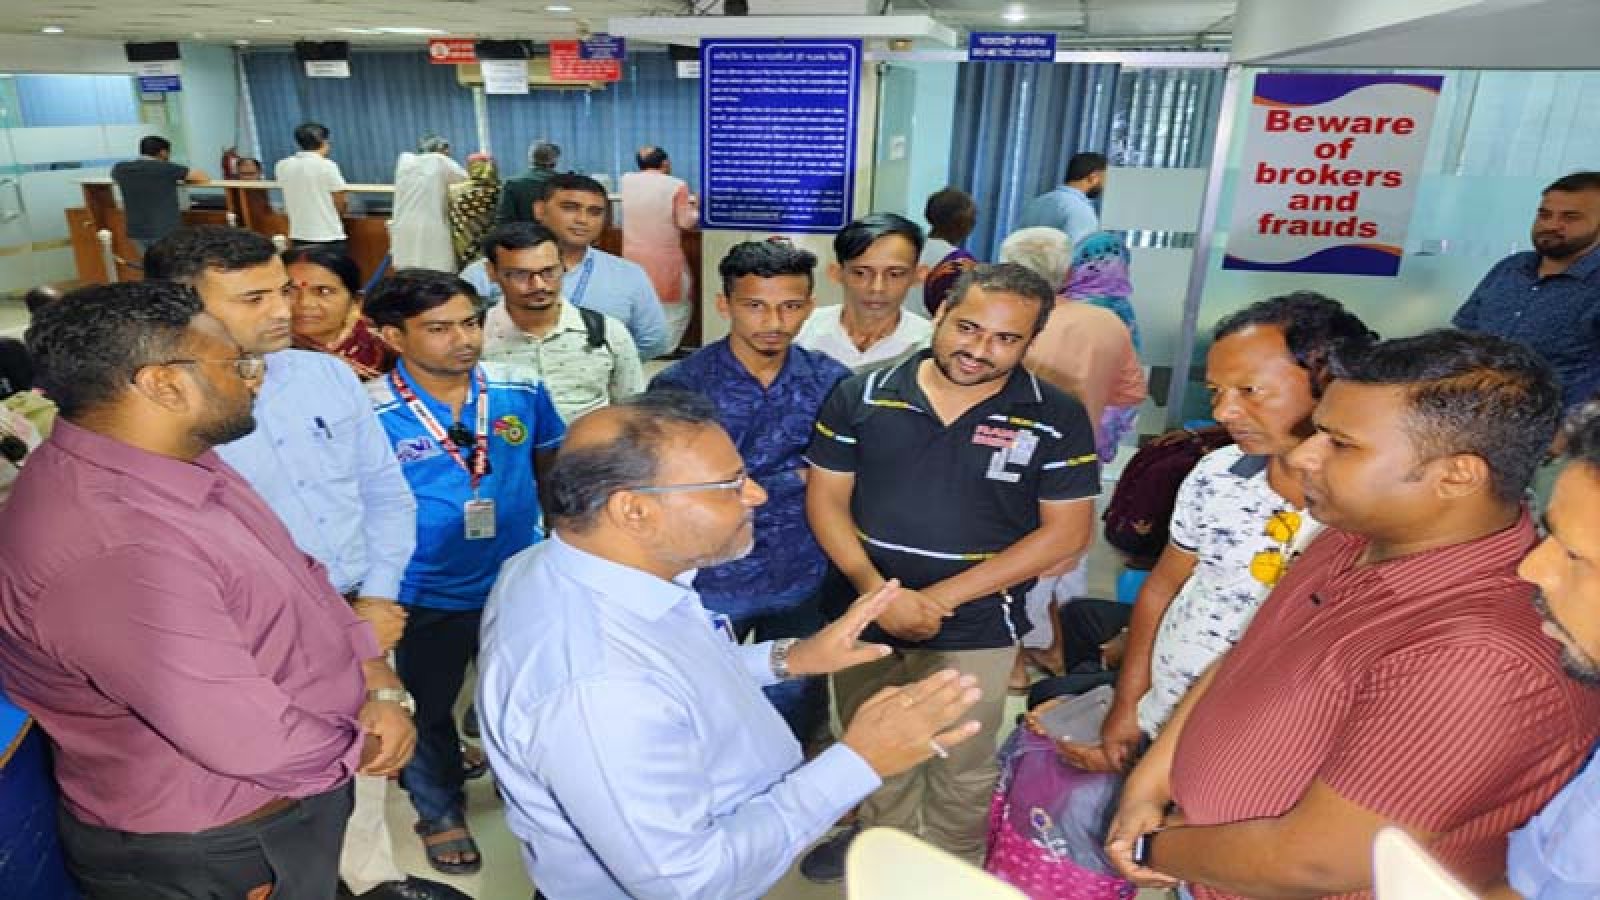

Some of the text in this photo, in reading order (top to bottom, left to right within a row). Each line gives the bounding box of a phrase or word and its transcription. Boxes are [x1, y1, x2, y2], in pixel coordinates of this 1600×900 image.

[1264, 109, 1415, 135] Beware
[1314, 138, 1355, 160] of
[1255, 161, 1402, 188] brokers
[1287, 190, 1360, 213] and
[1257, 213, 1378, 238] frauds
